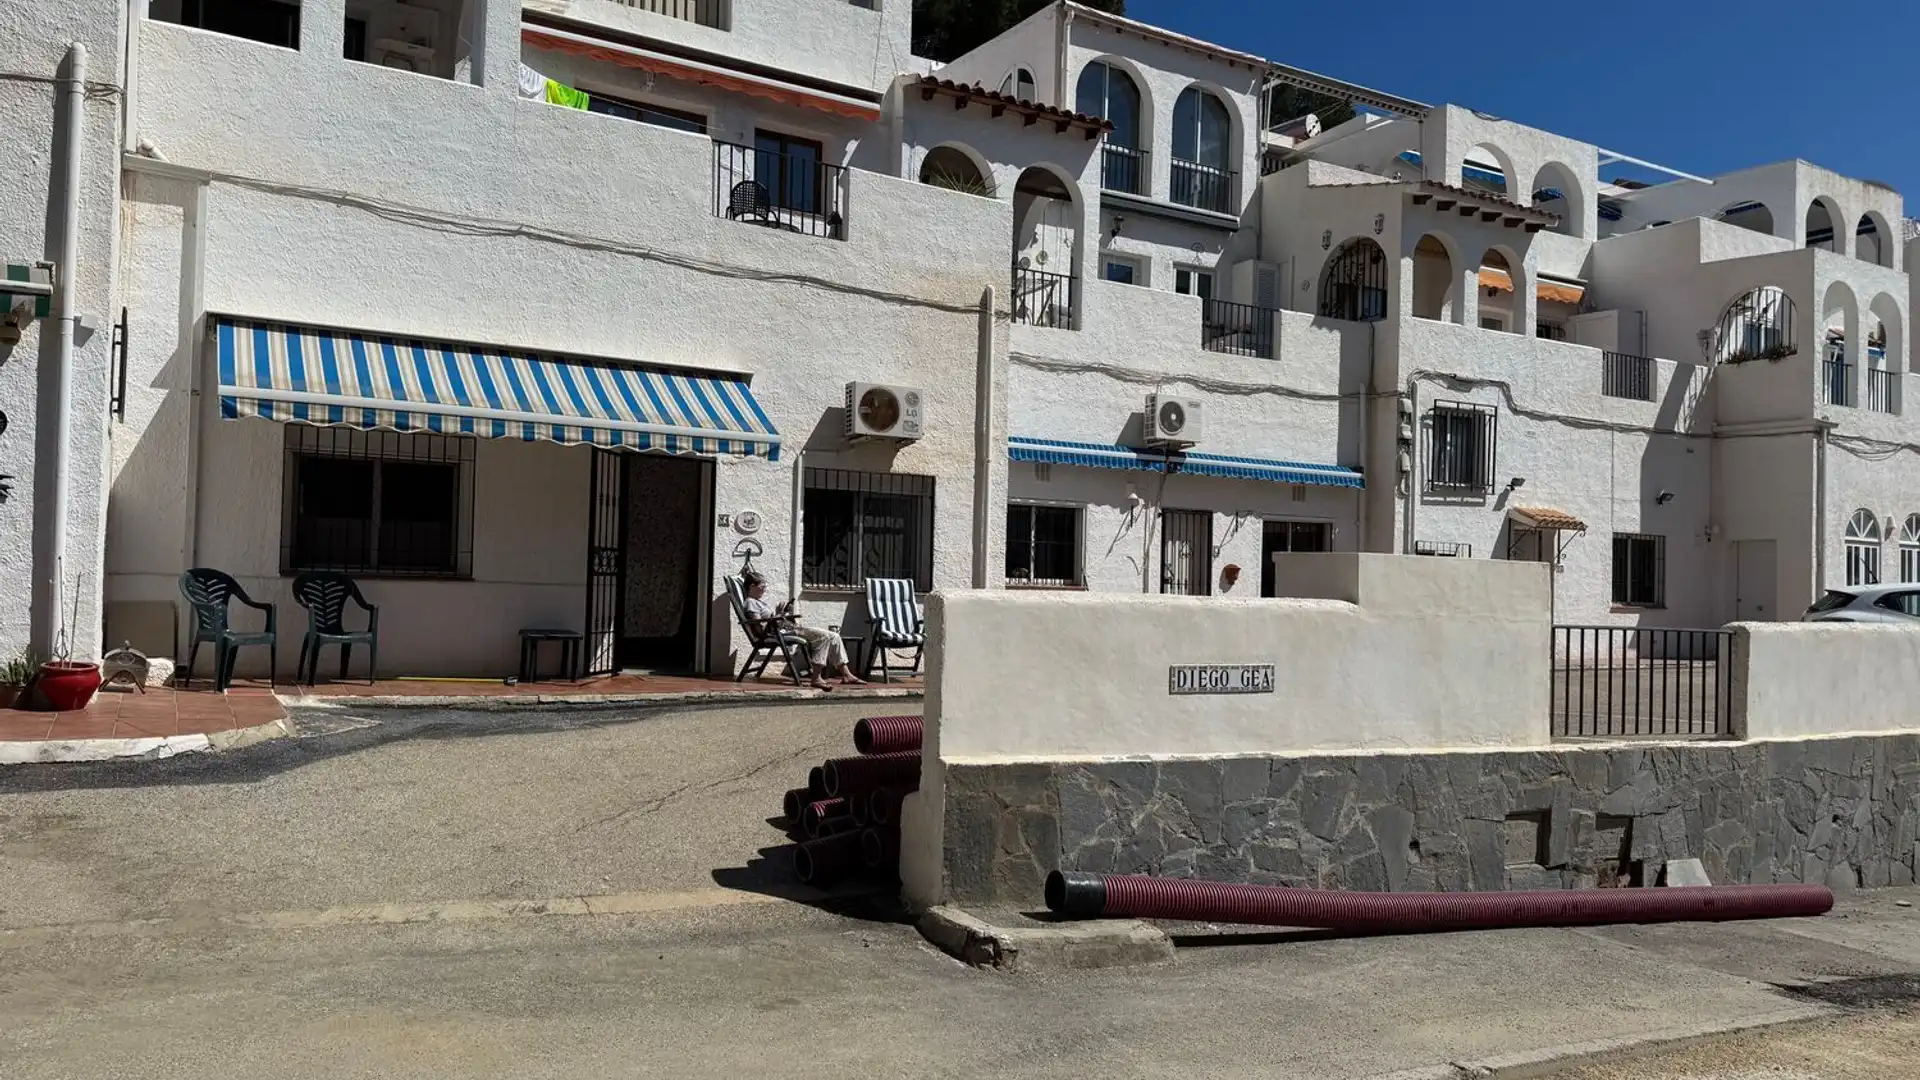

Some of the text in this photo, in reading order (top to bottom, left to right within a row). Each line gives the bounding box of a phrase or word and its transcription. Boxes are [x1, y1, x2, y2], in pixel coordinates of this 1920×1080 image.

[906, 408, 918, 417] LG
[1177, 669, 1270, 688] DIEGO GEA
